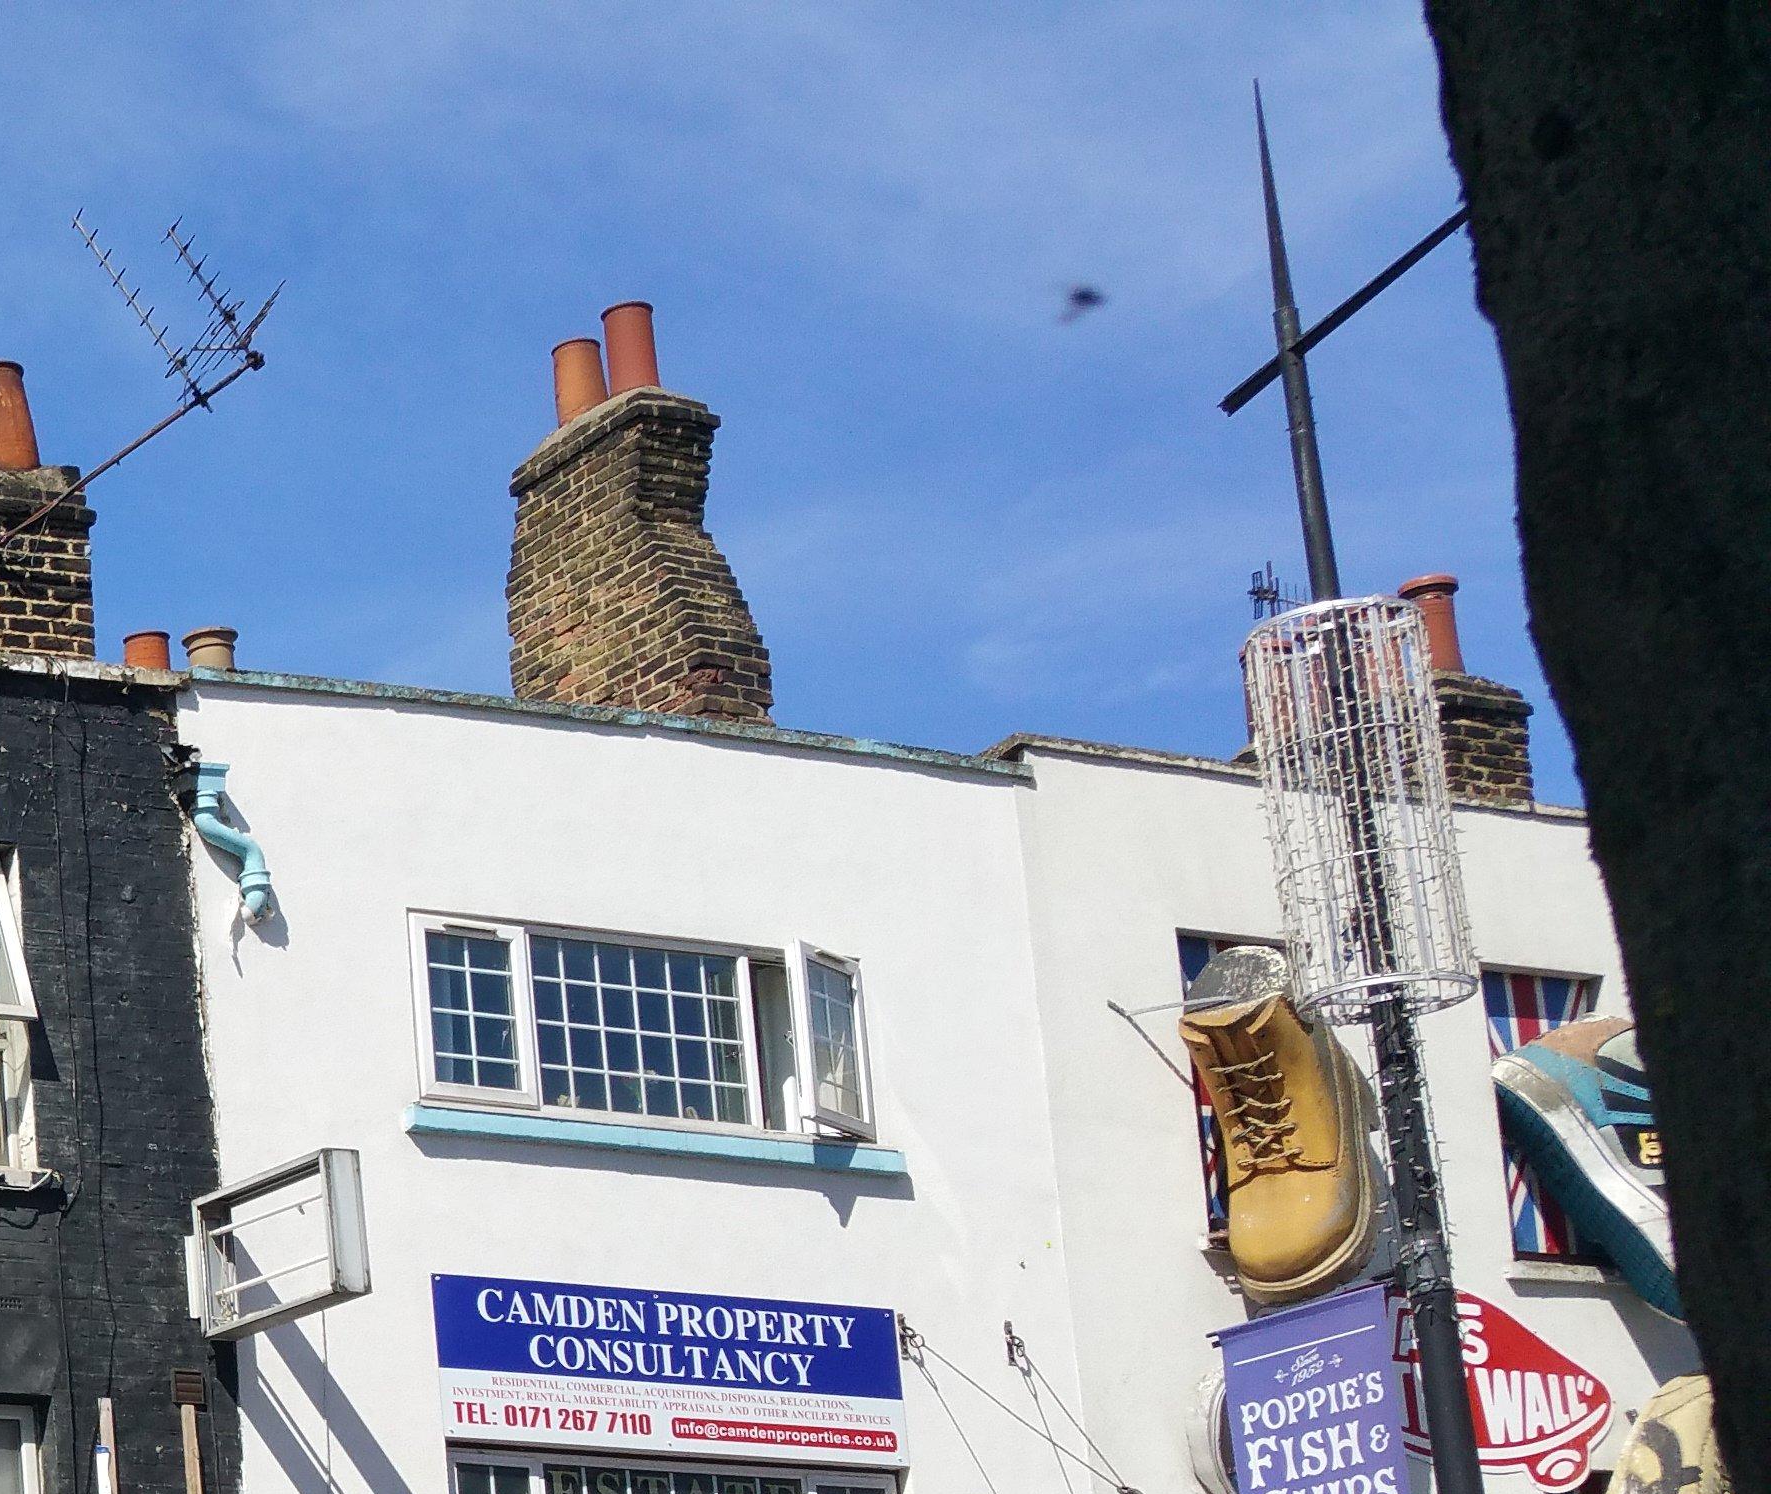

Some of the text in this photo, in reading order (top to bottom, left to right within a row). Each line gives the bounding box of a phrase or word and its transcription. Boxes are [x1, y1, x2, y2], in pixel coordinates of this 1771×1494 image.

[476, 1288, 856, 1350] CAMDEN PROPERTY
[529, 1335, 815, 1387] CONSULTANCY
[452, 1387, 525, 1401] INVESTMENT,
[526, 1392, 571, 1404] RENTAL,
[573, 1395, 658, 1410] MARKETABILITY
[661, 1402, 723, 1414] APPRAISALS
[728, 1406, 749, 1416] AND
[754, 1408, 791, 1419] OTHER
[843, 1413, 891, 1425] SERVICES
[453, 1401, 652, 1436] TEL: 0171 267 7110
[566, 1382, 641, 1397] COMMERCIAL,
[721, 1392, 776, 1405] DISPOSALS,
[781, 1397, 853, 1411] RELOCATIONS,
[1240, 1370, 1385, 1436] POPPIE'S
[675, 1420, 894, 1448] info@camdenproperties.co.uk
[1245, 1420, 1391, 1490] FISH &
